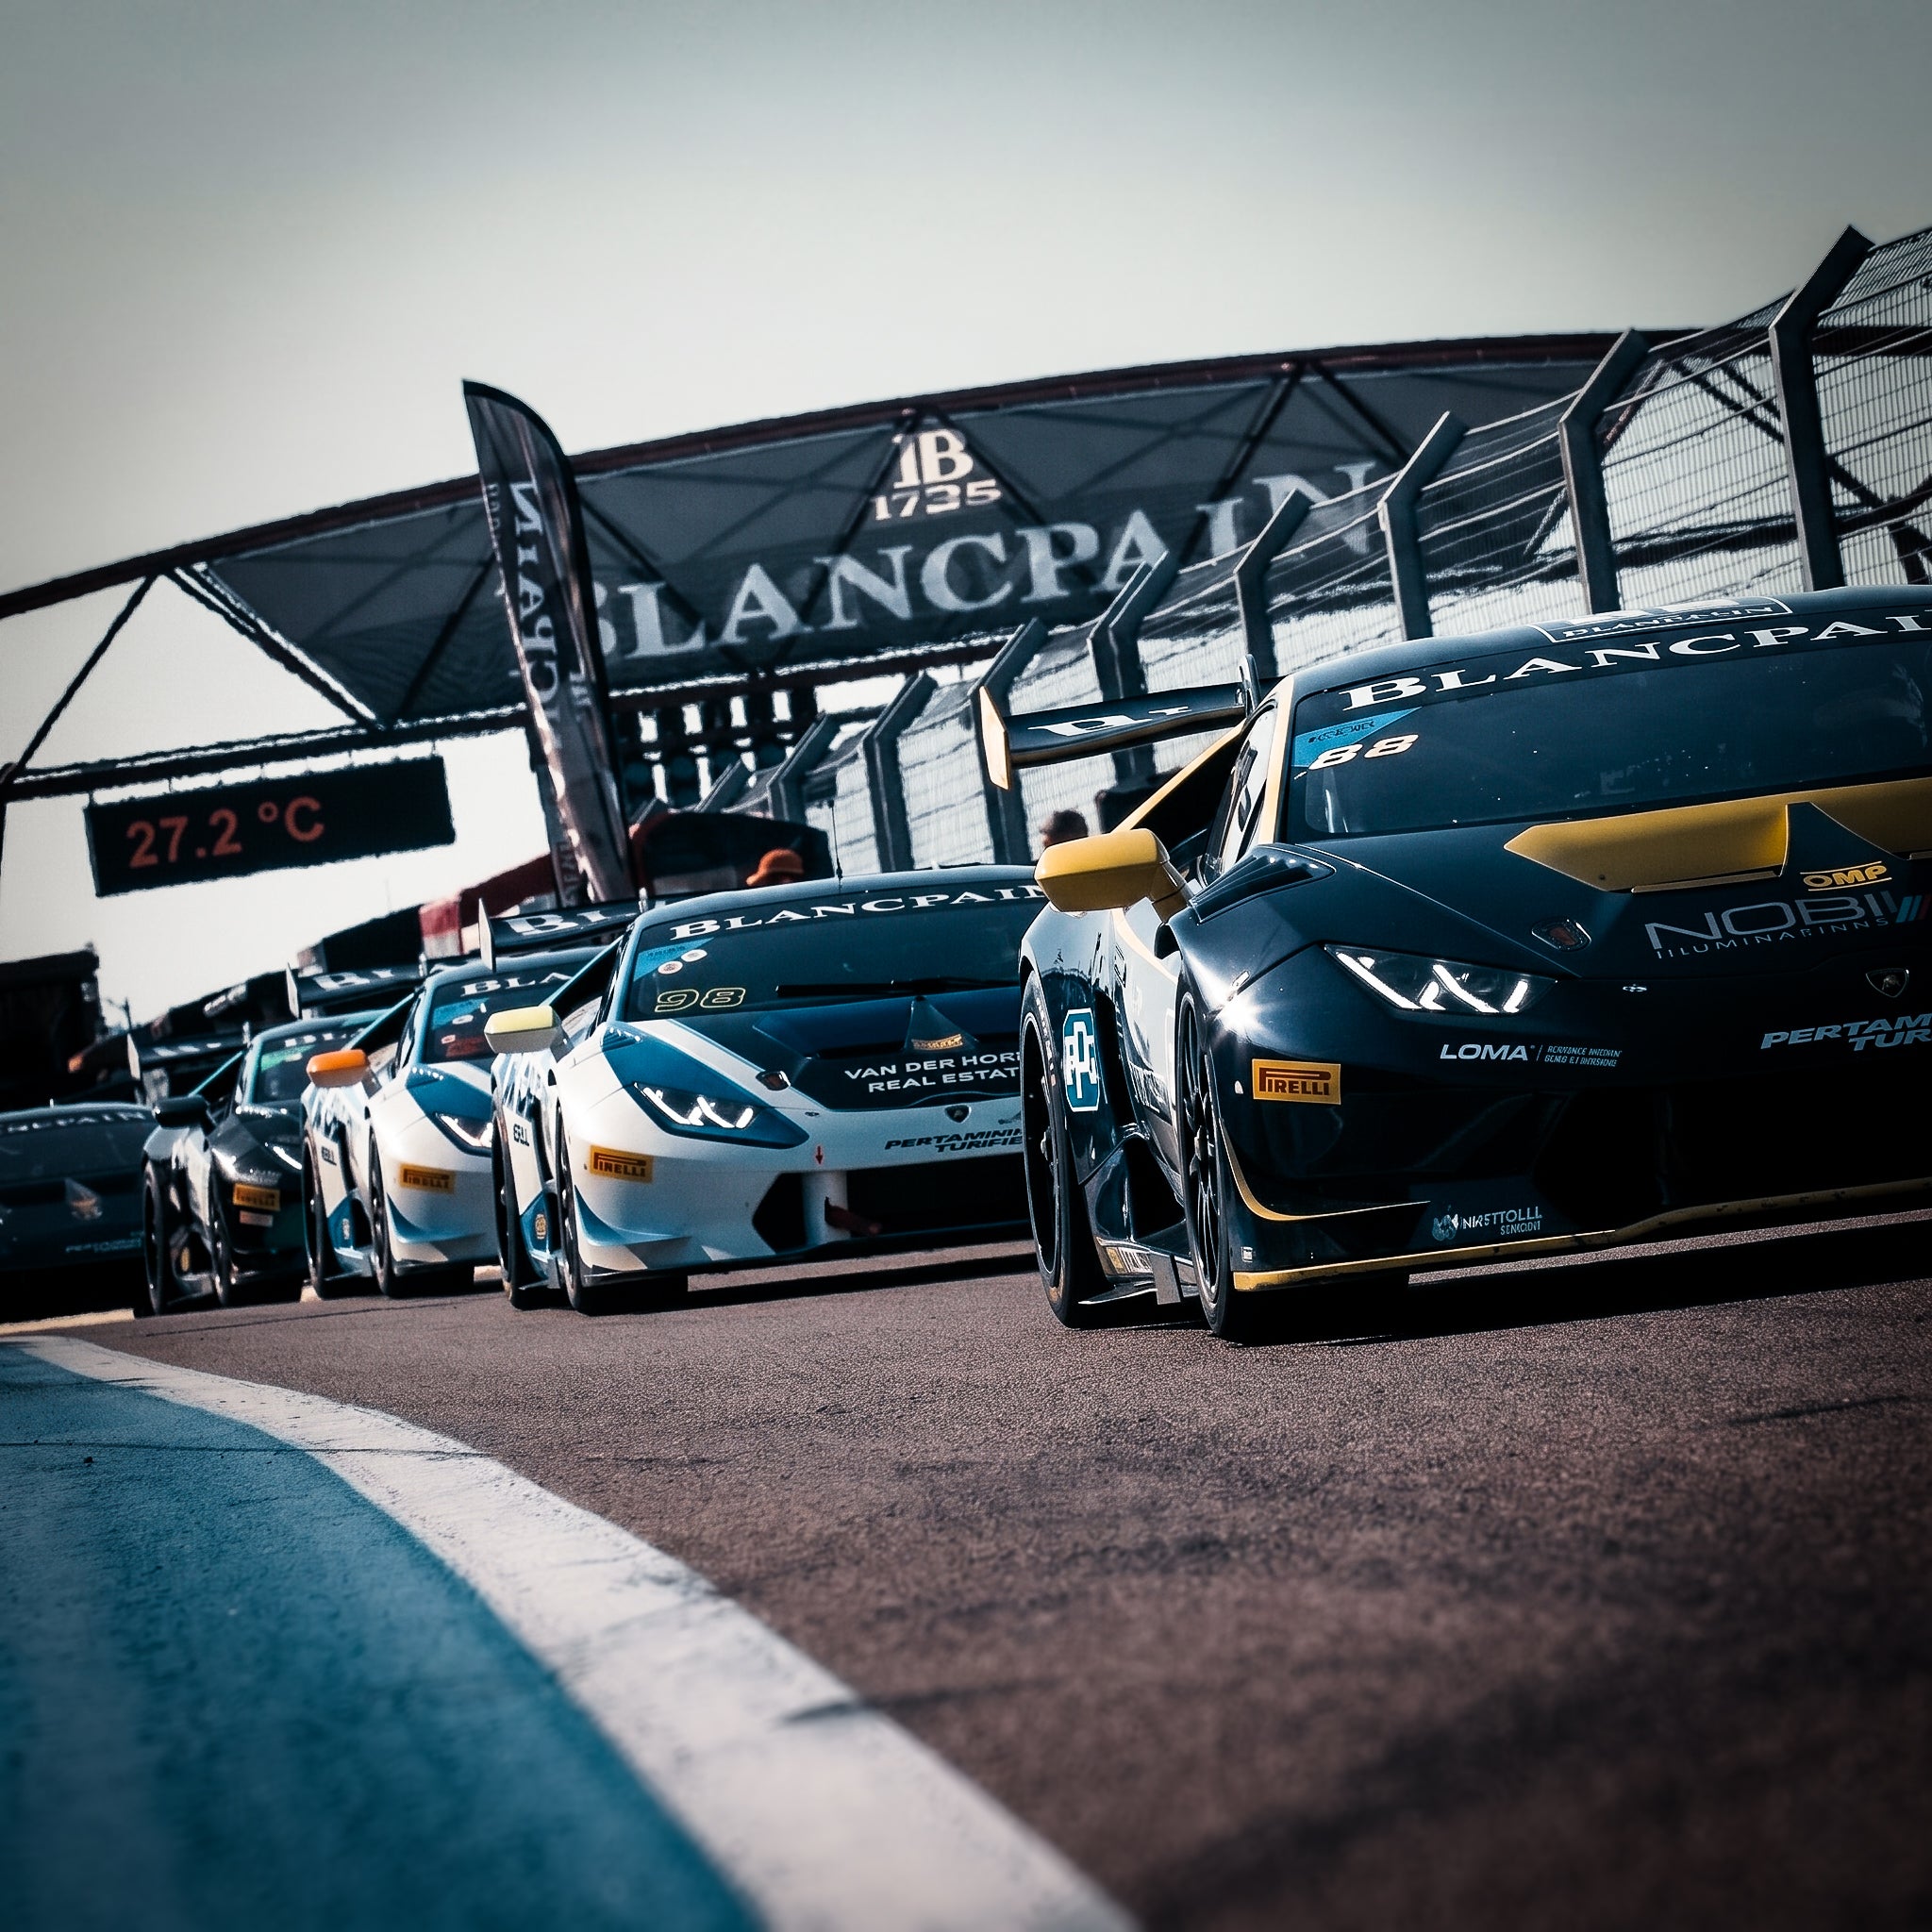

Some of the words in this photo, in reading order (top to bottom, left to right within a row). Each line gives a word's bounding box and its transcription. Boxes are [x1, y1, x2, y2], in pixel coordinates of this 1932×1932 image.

[871, 478, 1002, 521] 1735
[1341, 608, 1932, 712] BLANCPAI
[1307, 734, 1419, 771] 88
[126, 808, 242, 869] 27.2
[1803, 864, 1888, 889] OMP
[655, 987, 746, 1012] 98
[1440, 1043, 1529, 1061] LOMA
[843, 1064, 897, 1080] VAN
[906, 1058, 957, 1074] DER
[1258, 1067, 1332, 1096] PIRELLI
[868, 1076, 937, 1093] REAL
